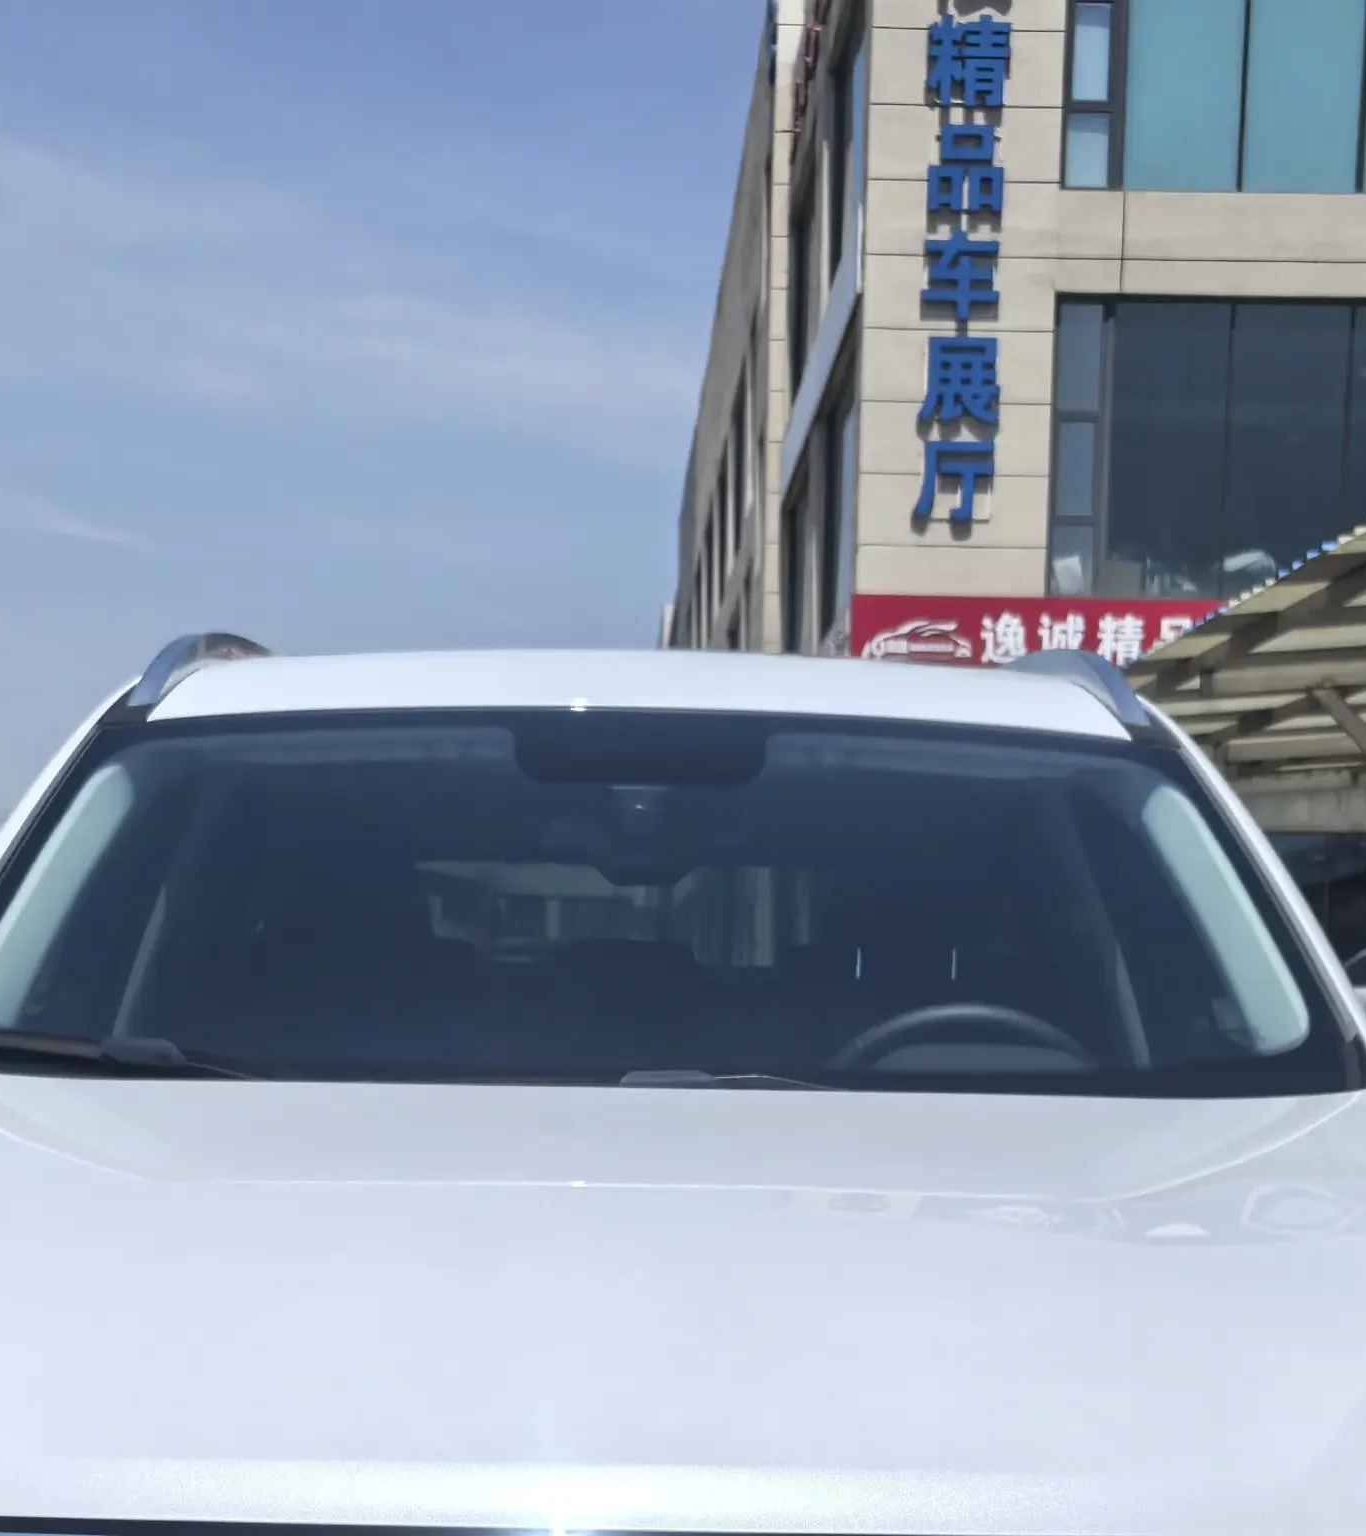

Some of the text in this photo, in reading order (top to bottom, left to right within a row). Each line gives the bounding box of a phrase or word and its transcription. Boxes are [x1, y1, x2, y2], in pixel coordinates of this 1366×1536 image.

[913, 13, 1011, 521] 精品车展厅
